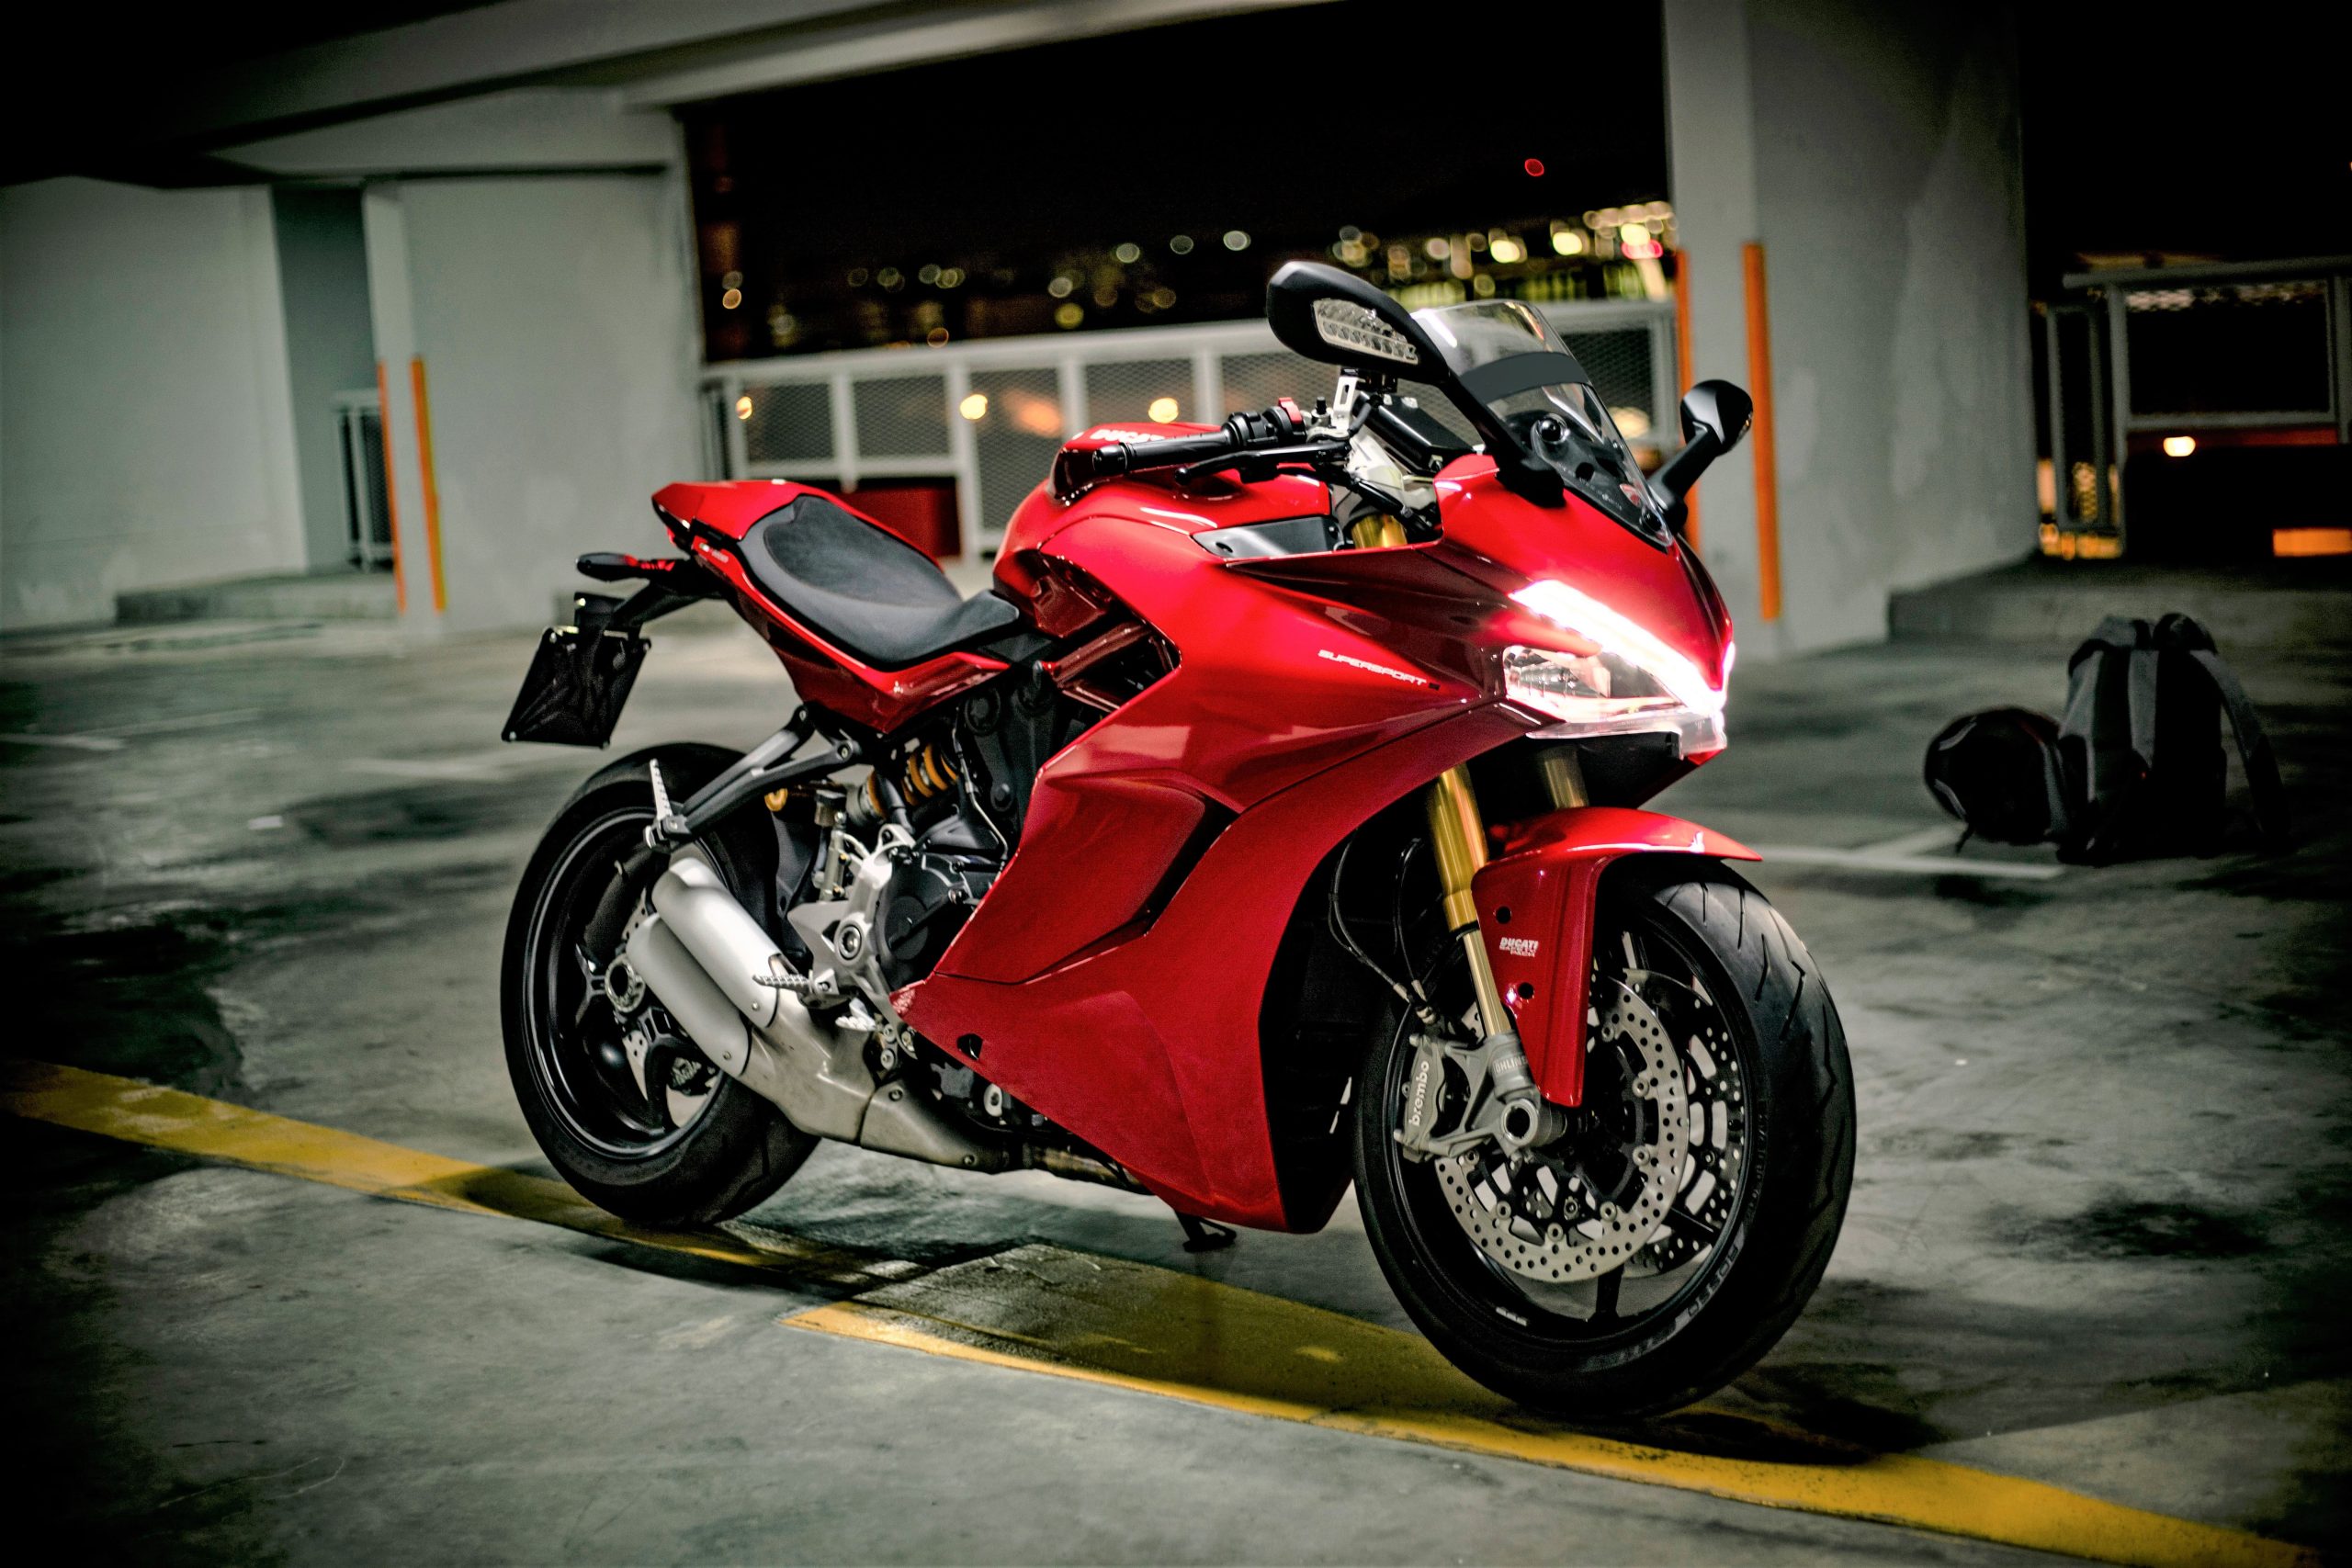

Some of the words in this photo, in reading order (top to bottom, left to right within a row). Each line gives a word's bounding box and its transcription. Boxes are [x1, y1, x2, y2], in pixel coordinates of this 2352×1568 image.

[1317, 649, 1427, 686] SUPERSPORT
[1499, 936, 1539, 951] DUCATI
[1408, 1060, 1430, 1127] brembo
